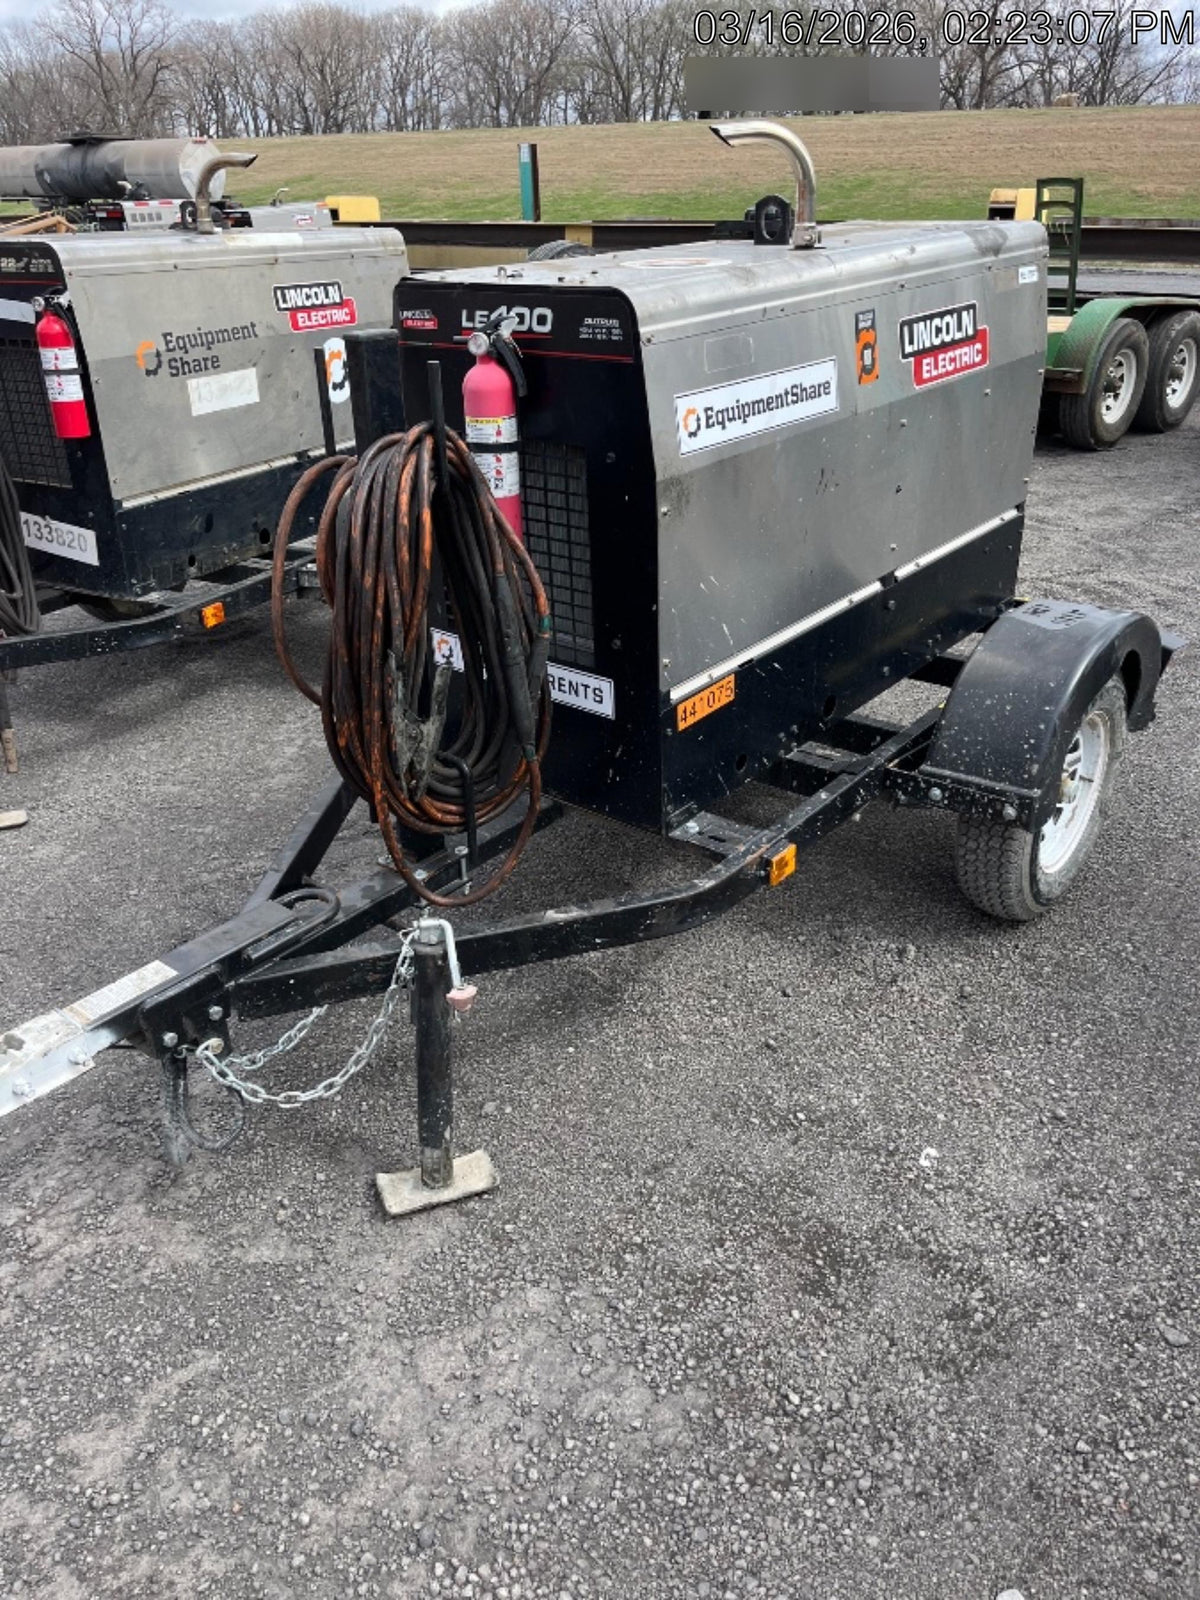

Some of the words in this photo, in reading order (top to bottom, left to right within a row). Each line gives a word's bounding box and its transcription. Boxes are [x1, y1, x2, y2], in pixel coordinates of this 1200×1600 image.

[277, 285, 341, 308] LINCOLN
[297, 308, 352, 327] ELECTRIC
[903, 309, 975, 354] LINCOLN
[161, 322, 258, 353] Equipment
[168, 354, 221, 378] Share
[922, 343, 983, 379] ELECTRIC
[704, 380, 831, 430] EquipmentShare
[23, 519, 88, 553] 133820
[547, 673, 604, 705] RENTS
